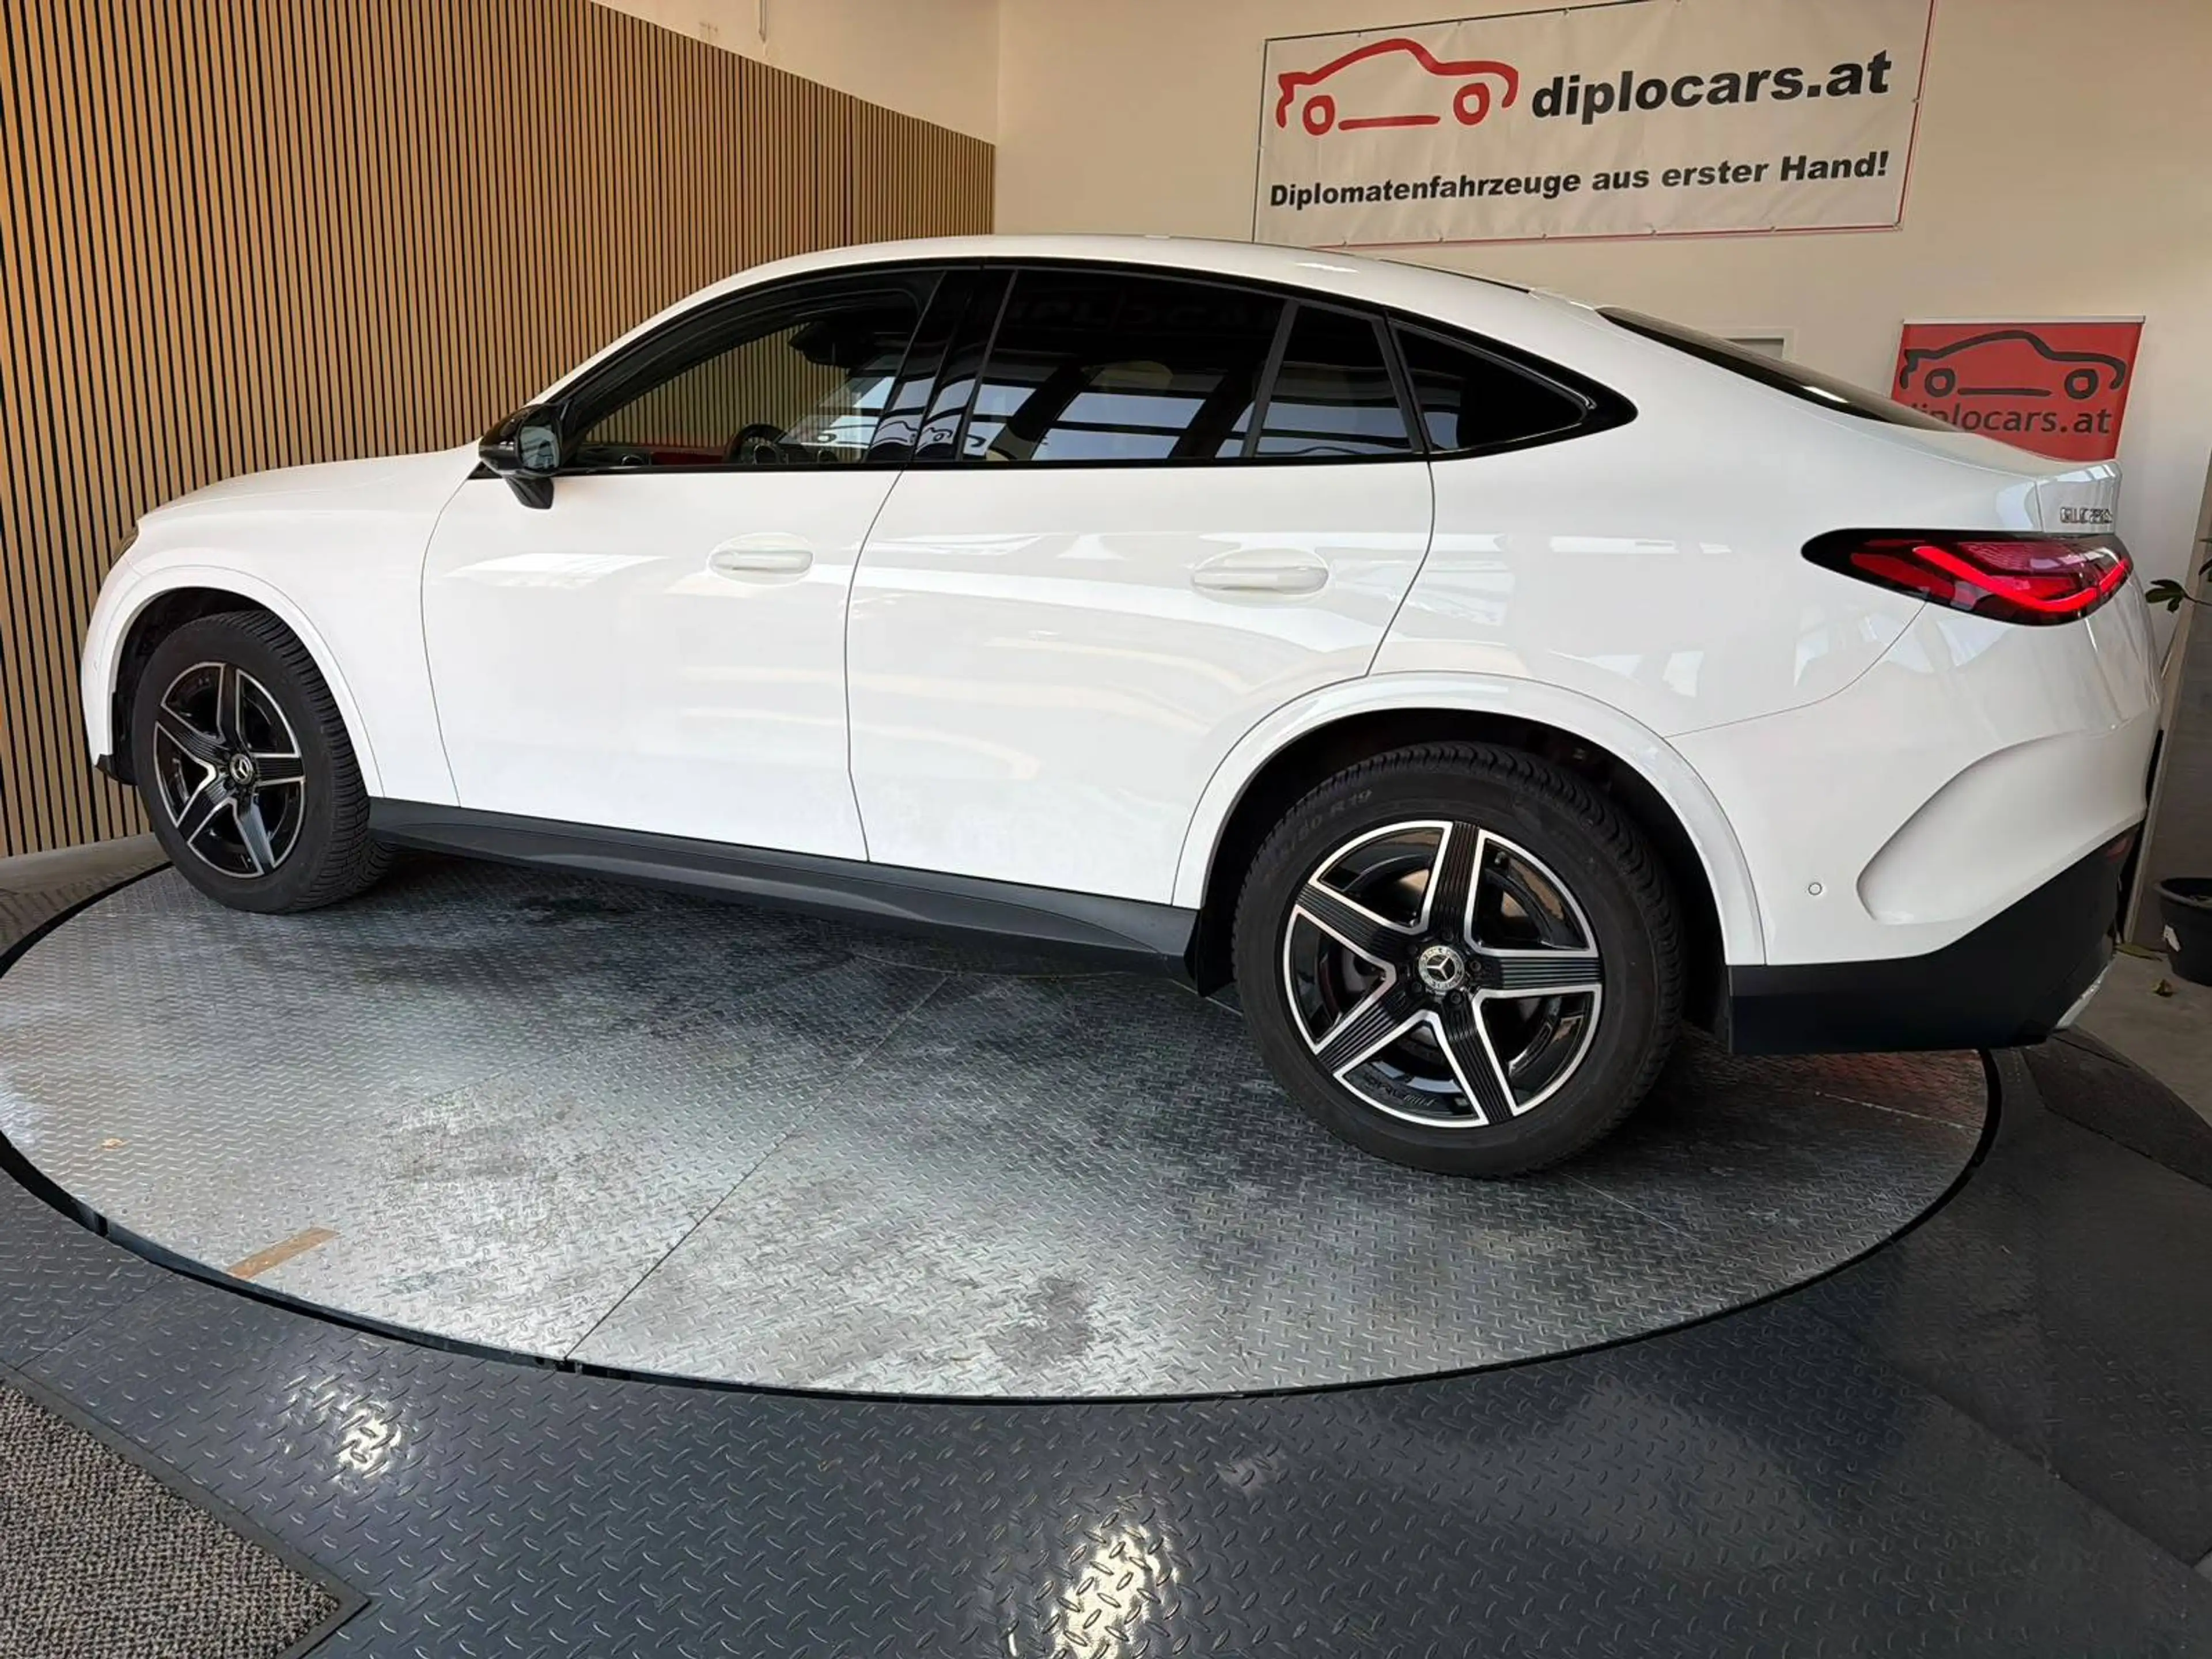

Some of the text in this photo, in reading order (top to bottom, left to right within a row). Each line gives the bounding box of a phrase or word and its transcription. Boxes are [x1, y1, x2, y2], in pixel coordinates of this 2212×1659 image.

[1532, 50, 1892, 125] diplocars.at
[1270, 150, 1889, 211] Diplomatenfahrzeuge aus erster Hand!
[1911, 402, 2112, 434] locars.at
